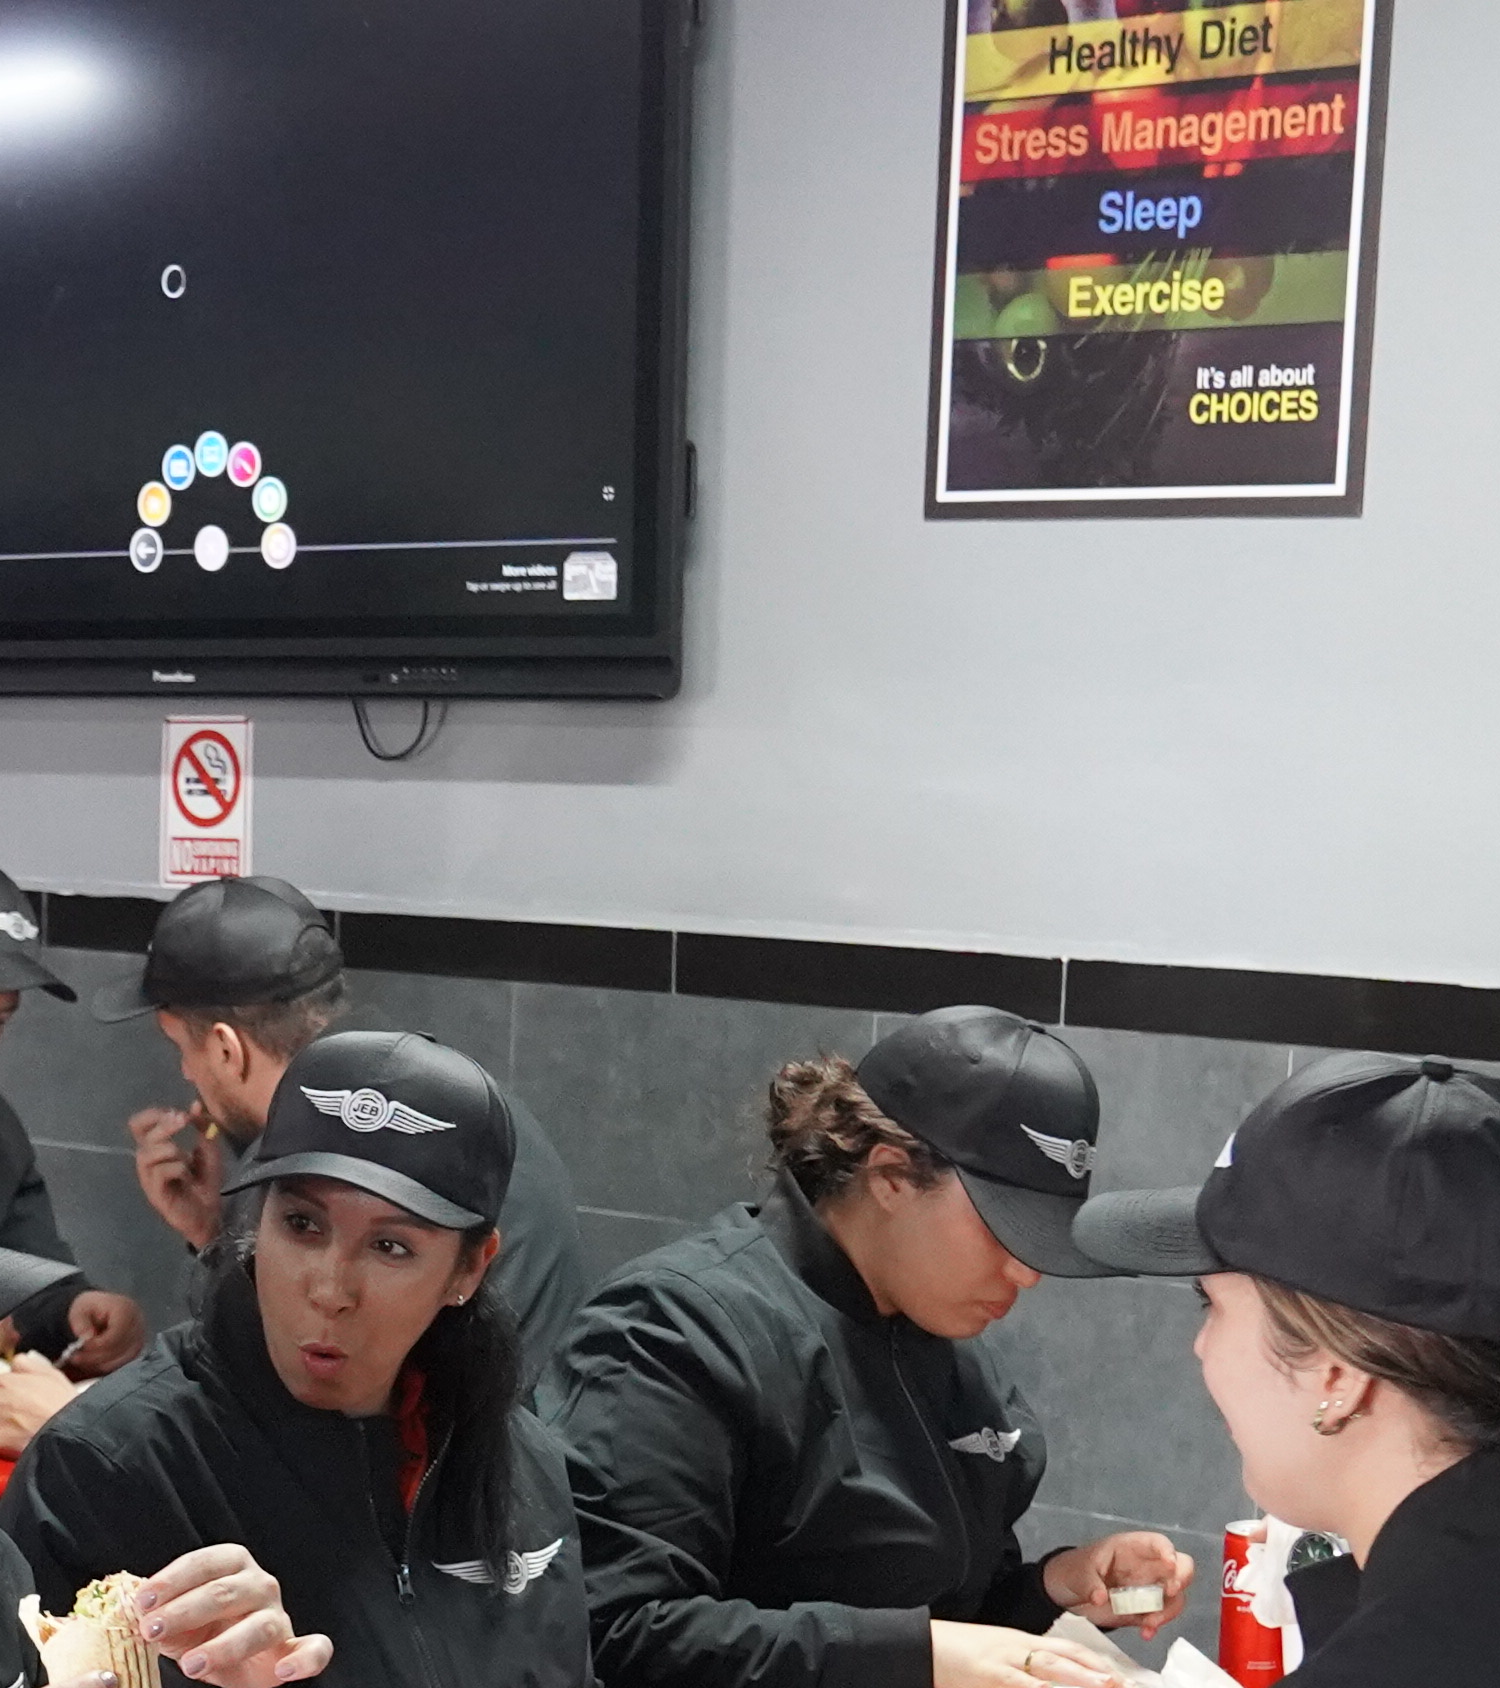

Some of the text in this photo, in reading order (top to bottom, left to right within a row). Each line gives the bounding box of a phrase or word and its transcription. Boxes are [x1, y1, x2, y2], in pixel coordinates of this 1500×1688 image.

[1049, 14, 1274, 75] Healthy Diet
[975, 92, 1346, 165] Stress Management
[1099, 191, 1202, 239] Sleep
[1067, 270, 1225, 319] Exercise
[1196, 364, 1316, 390] It's all about
[1188, 390, 1320, 425] CHOICES
[172, 840, 194, 873] NO
[353, 1103, 379, 1117] JEB
